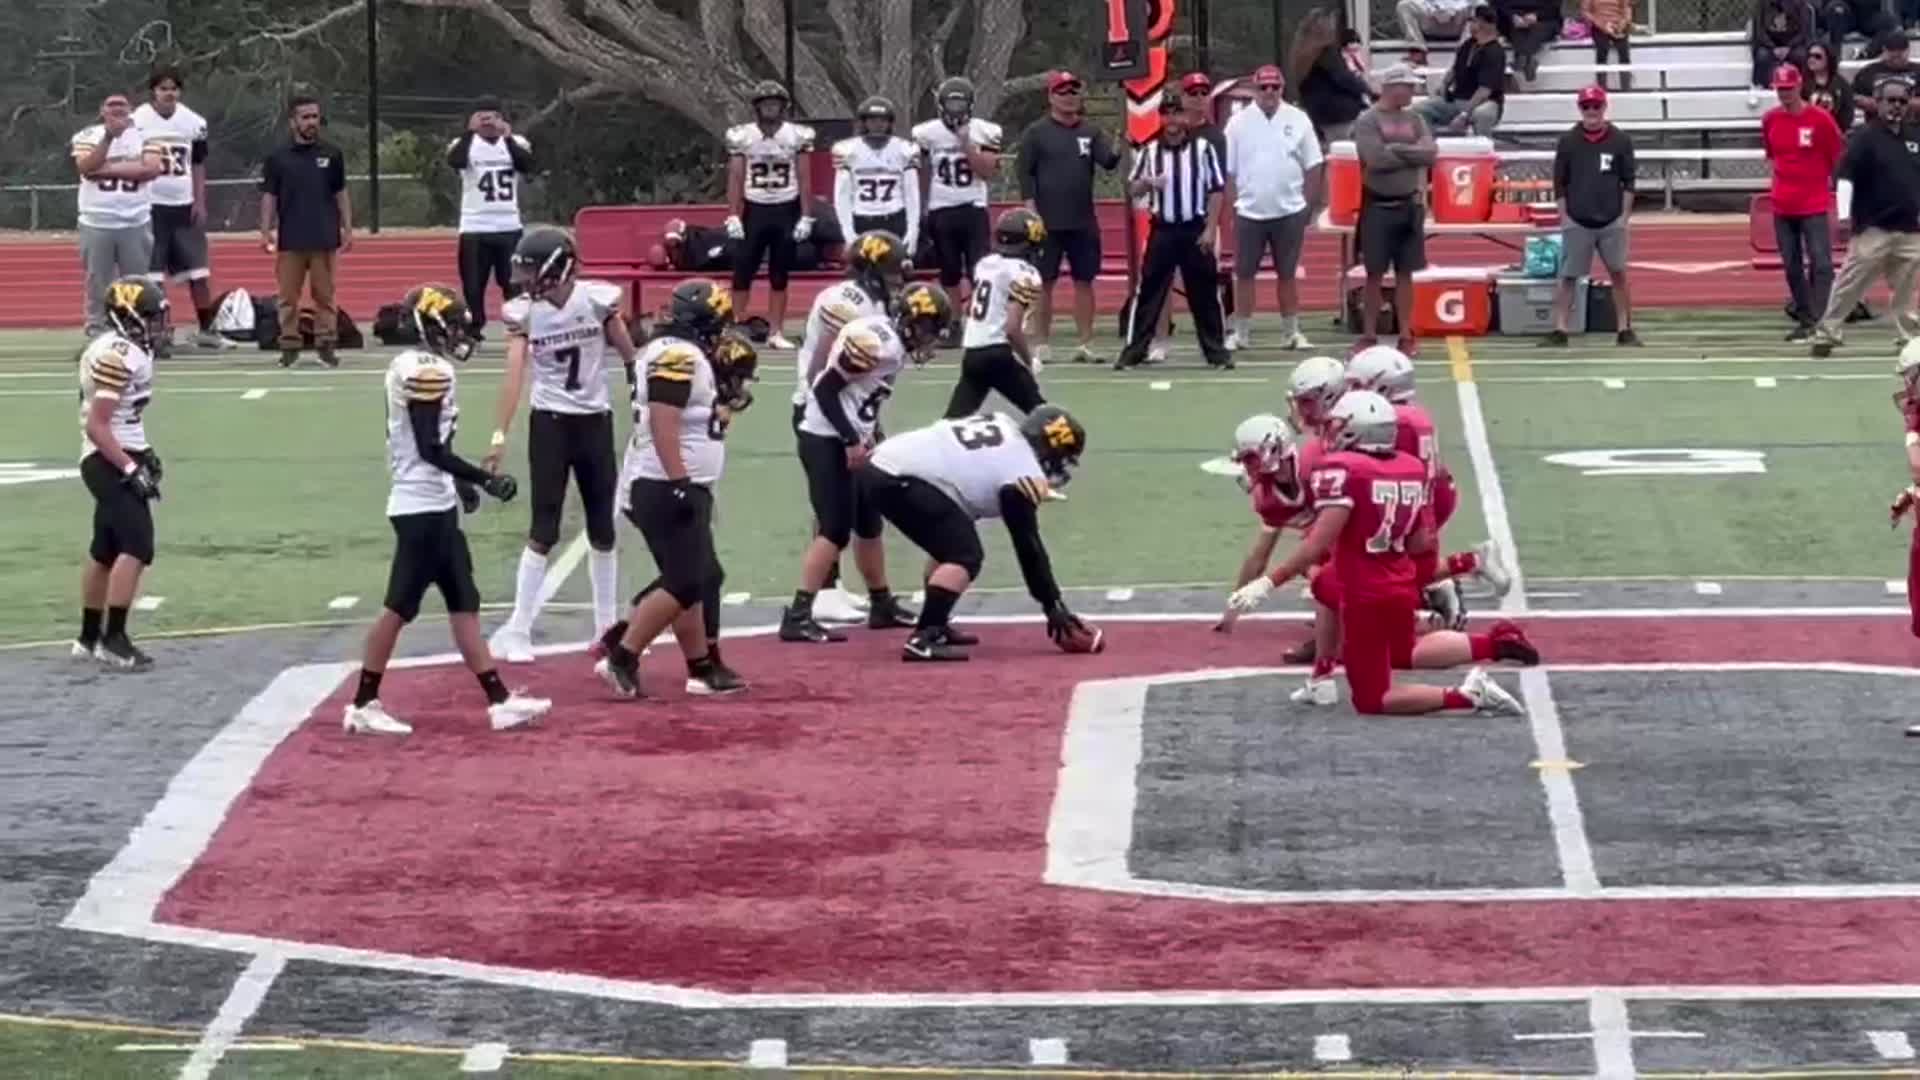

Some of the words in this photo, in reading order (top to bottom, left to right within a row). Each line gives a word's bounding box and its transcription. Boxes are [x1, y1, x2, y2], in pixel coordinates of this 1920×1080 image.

[478, 169, 514, 202] 45
[750, 162, 791, 188] 23
[858, 179, 897, 202] 37
[1452, 166, 1472, 186] G
[1434, 289, 1466, 324] G
[555, 346, 582, 391] 7
[1363, 478, 1425, 554] 77
